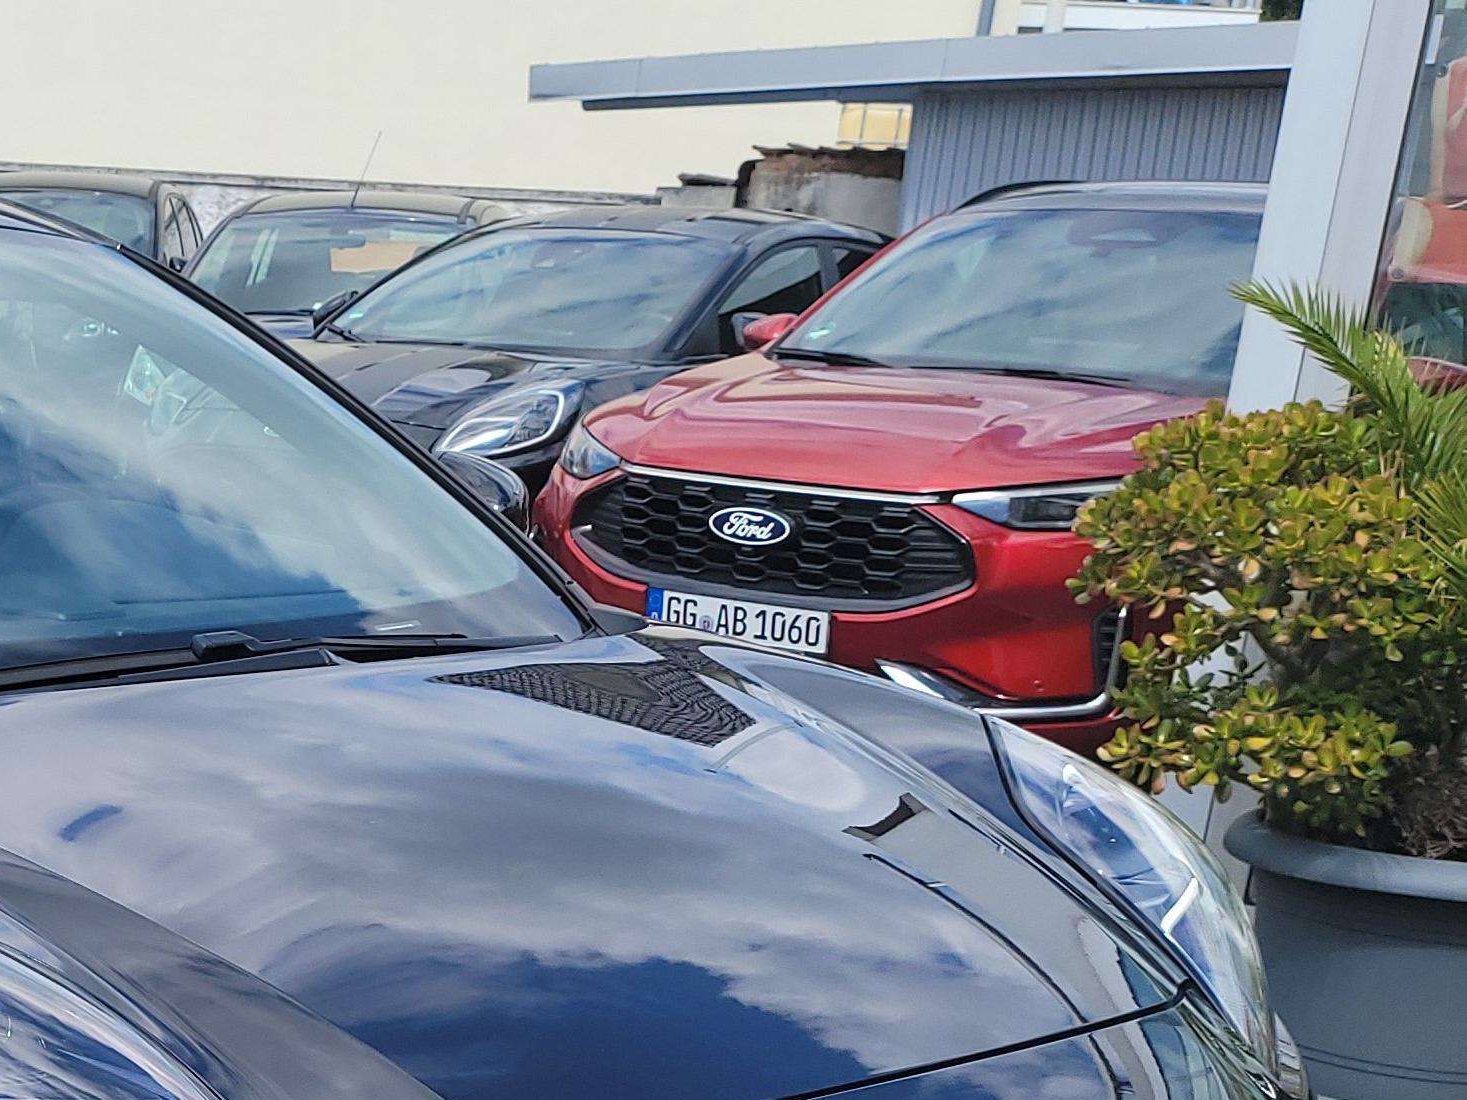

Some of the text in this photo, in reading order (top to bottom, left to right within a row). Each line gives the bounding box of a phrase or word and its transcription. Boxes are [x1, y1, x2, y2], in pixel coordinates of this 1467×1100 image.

[723, 512, 775, 539] Ford
[667, 596, 698, 628] GG
[715, 604, 747, 636] AB
[753, 610, 821, 647] 1060
